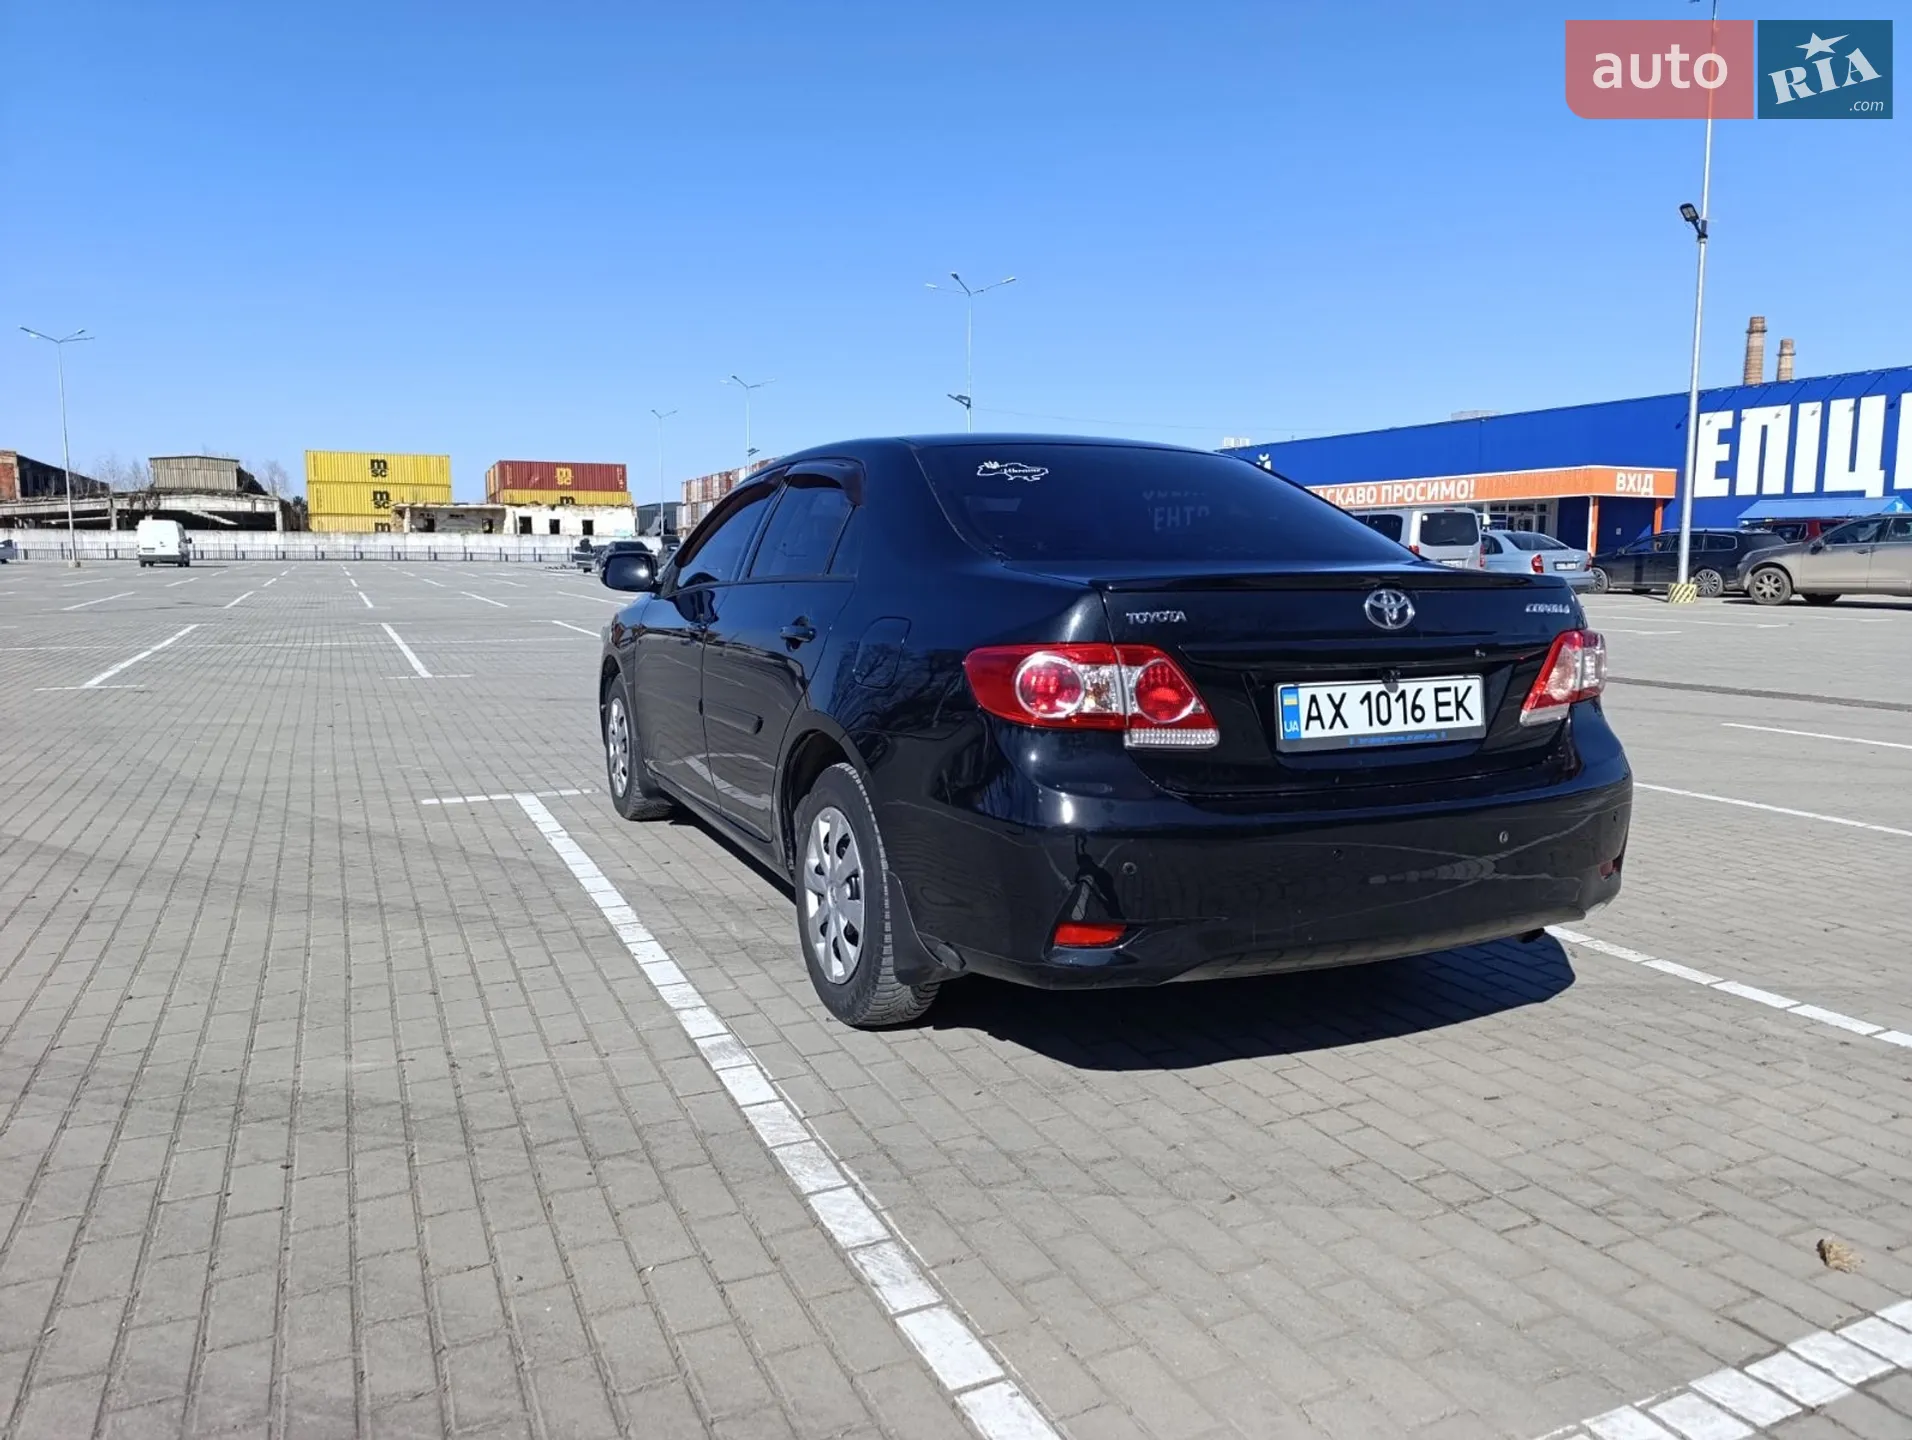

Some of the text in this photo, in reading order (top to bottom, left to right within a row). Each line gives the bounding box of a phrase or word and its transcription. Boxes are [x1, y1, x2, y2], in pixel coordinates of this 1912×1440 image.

[1312, 479, 1475, 505] АСКАВО ПРОСИМО!
[1615, 471, 1654, 496] ВХІД
[1126, 610, 1188, 624] TOYOTA
[1305, 686, 1475, 731] AX 1016 EK
[1283, 720, 1300, 733] UA
